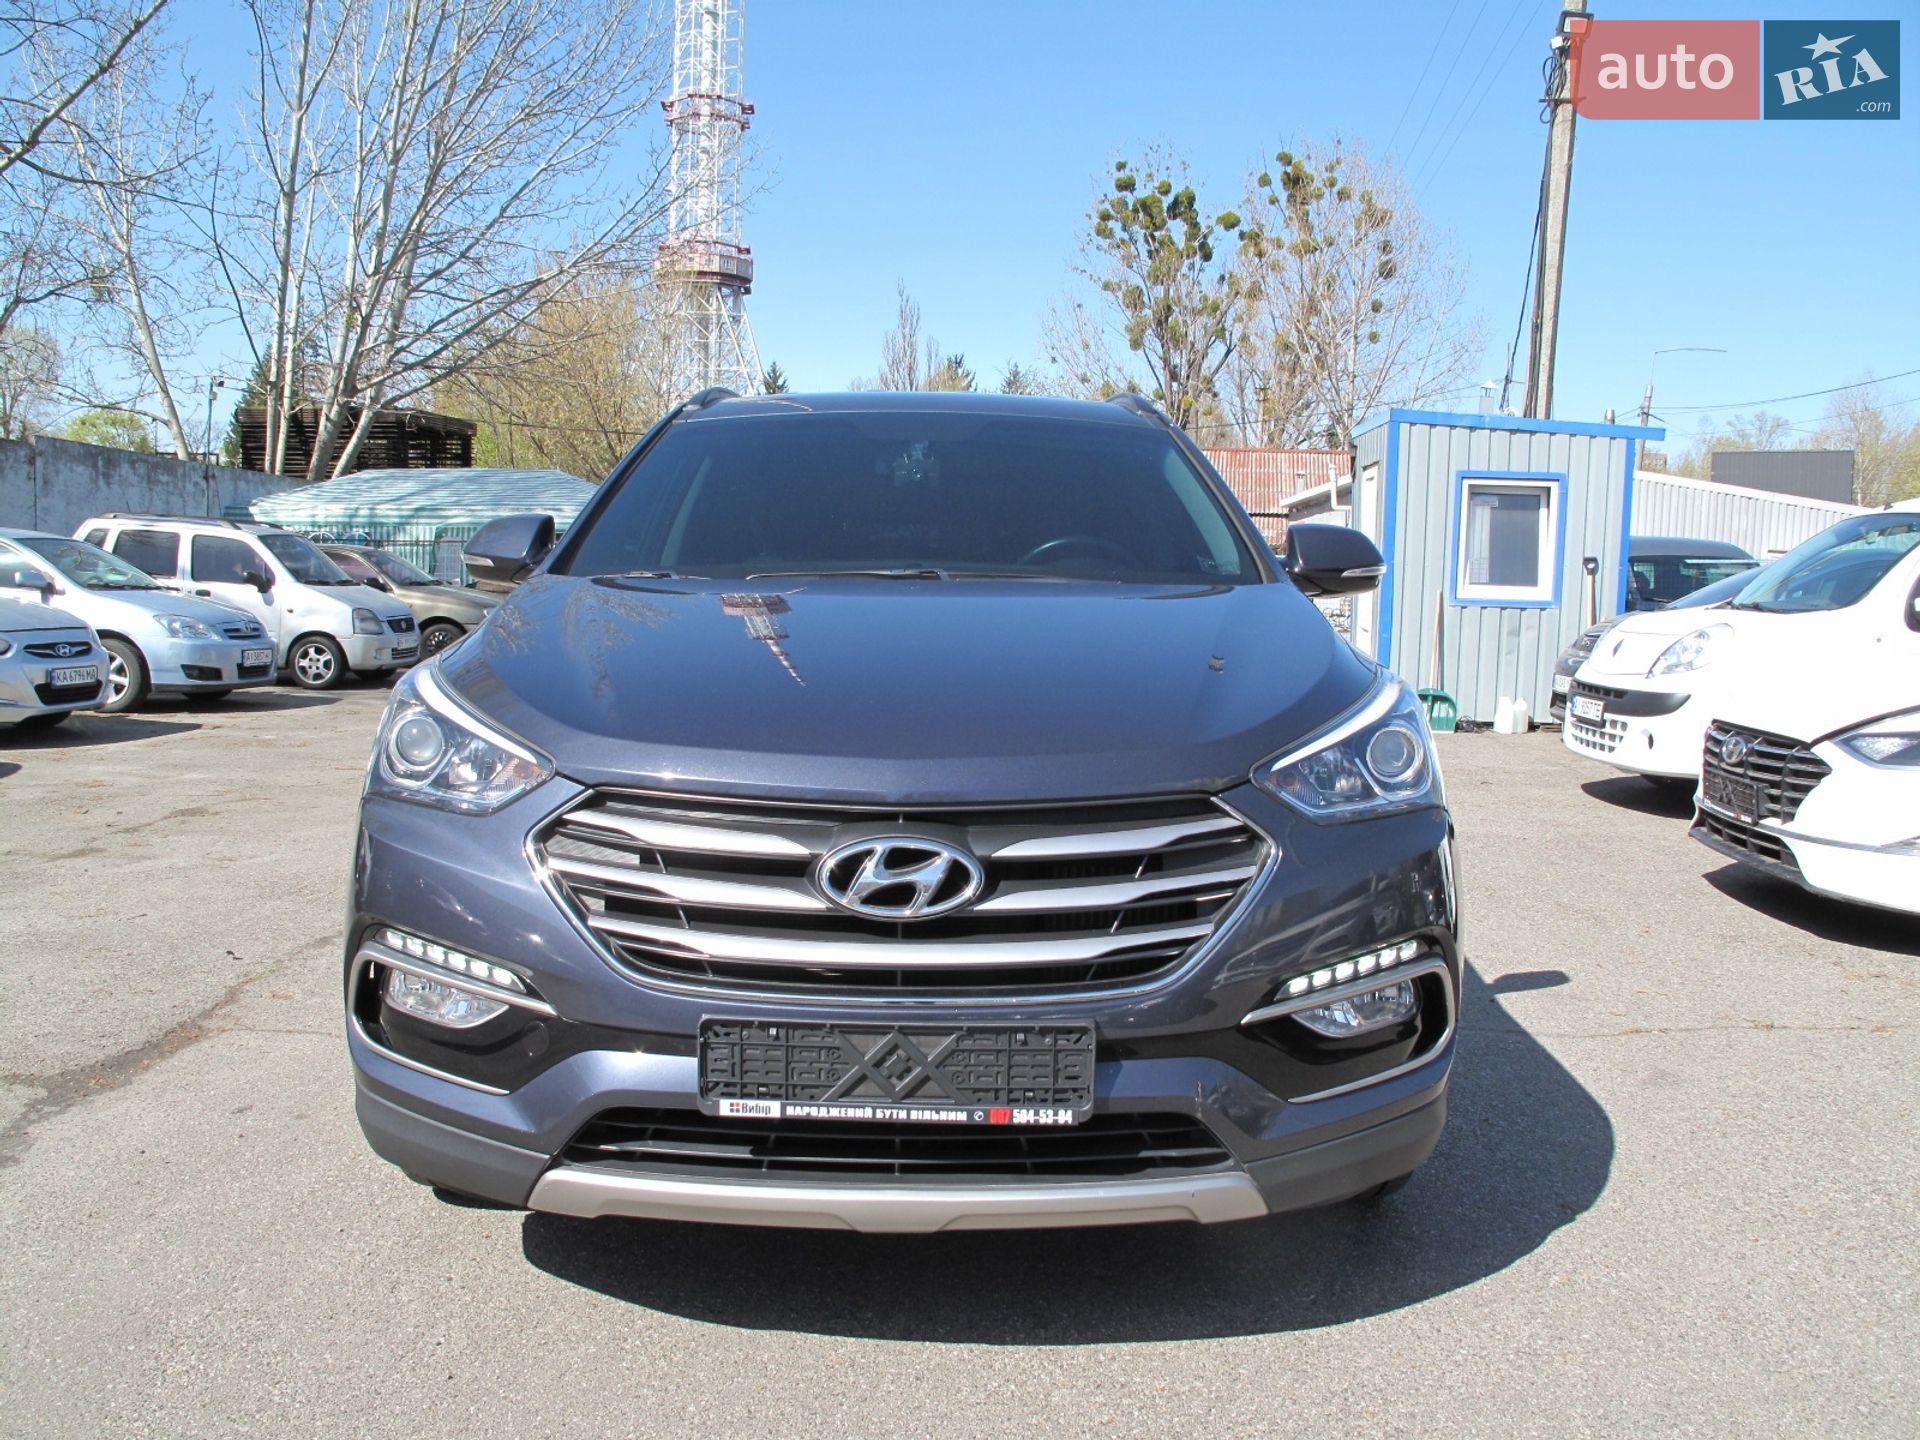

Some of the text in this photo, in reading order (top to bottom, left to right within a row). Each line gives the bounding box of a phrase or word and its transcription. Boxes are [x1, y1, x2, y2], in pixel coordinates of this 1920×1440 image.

[741, 1103, 771, 1115] Вибір
[786, 1105, 967, 1121] НАРОДЖЕНИЙ БУТИ ВІЛЬНИМ
